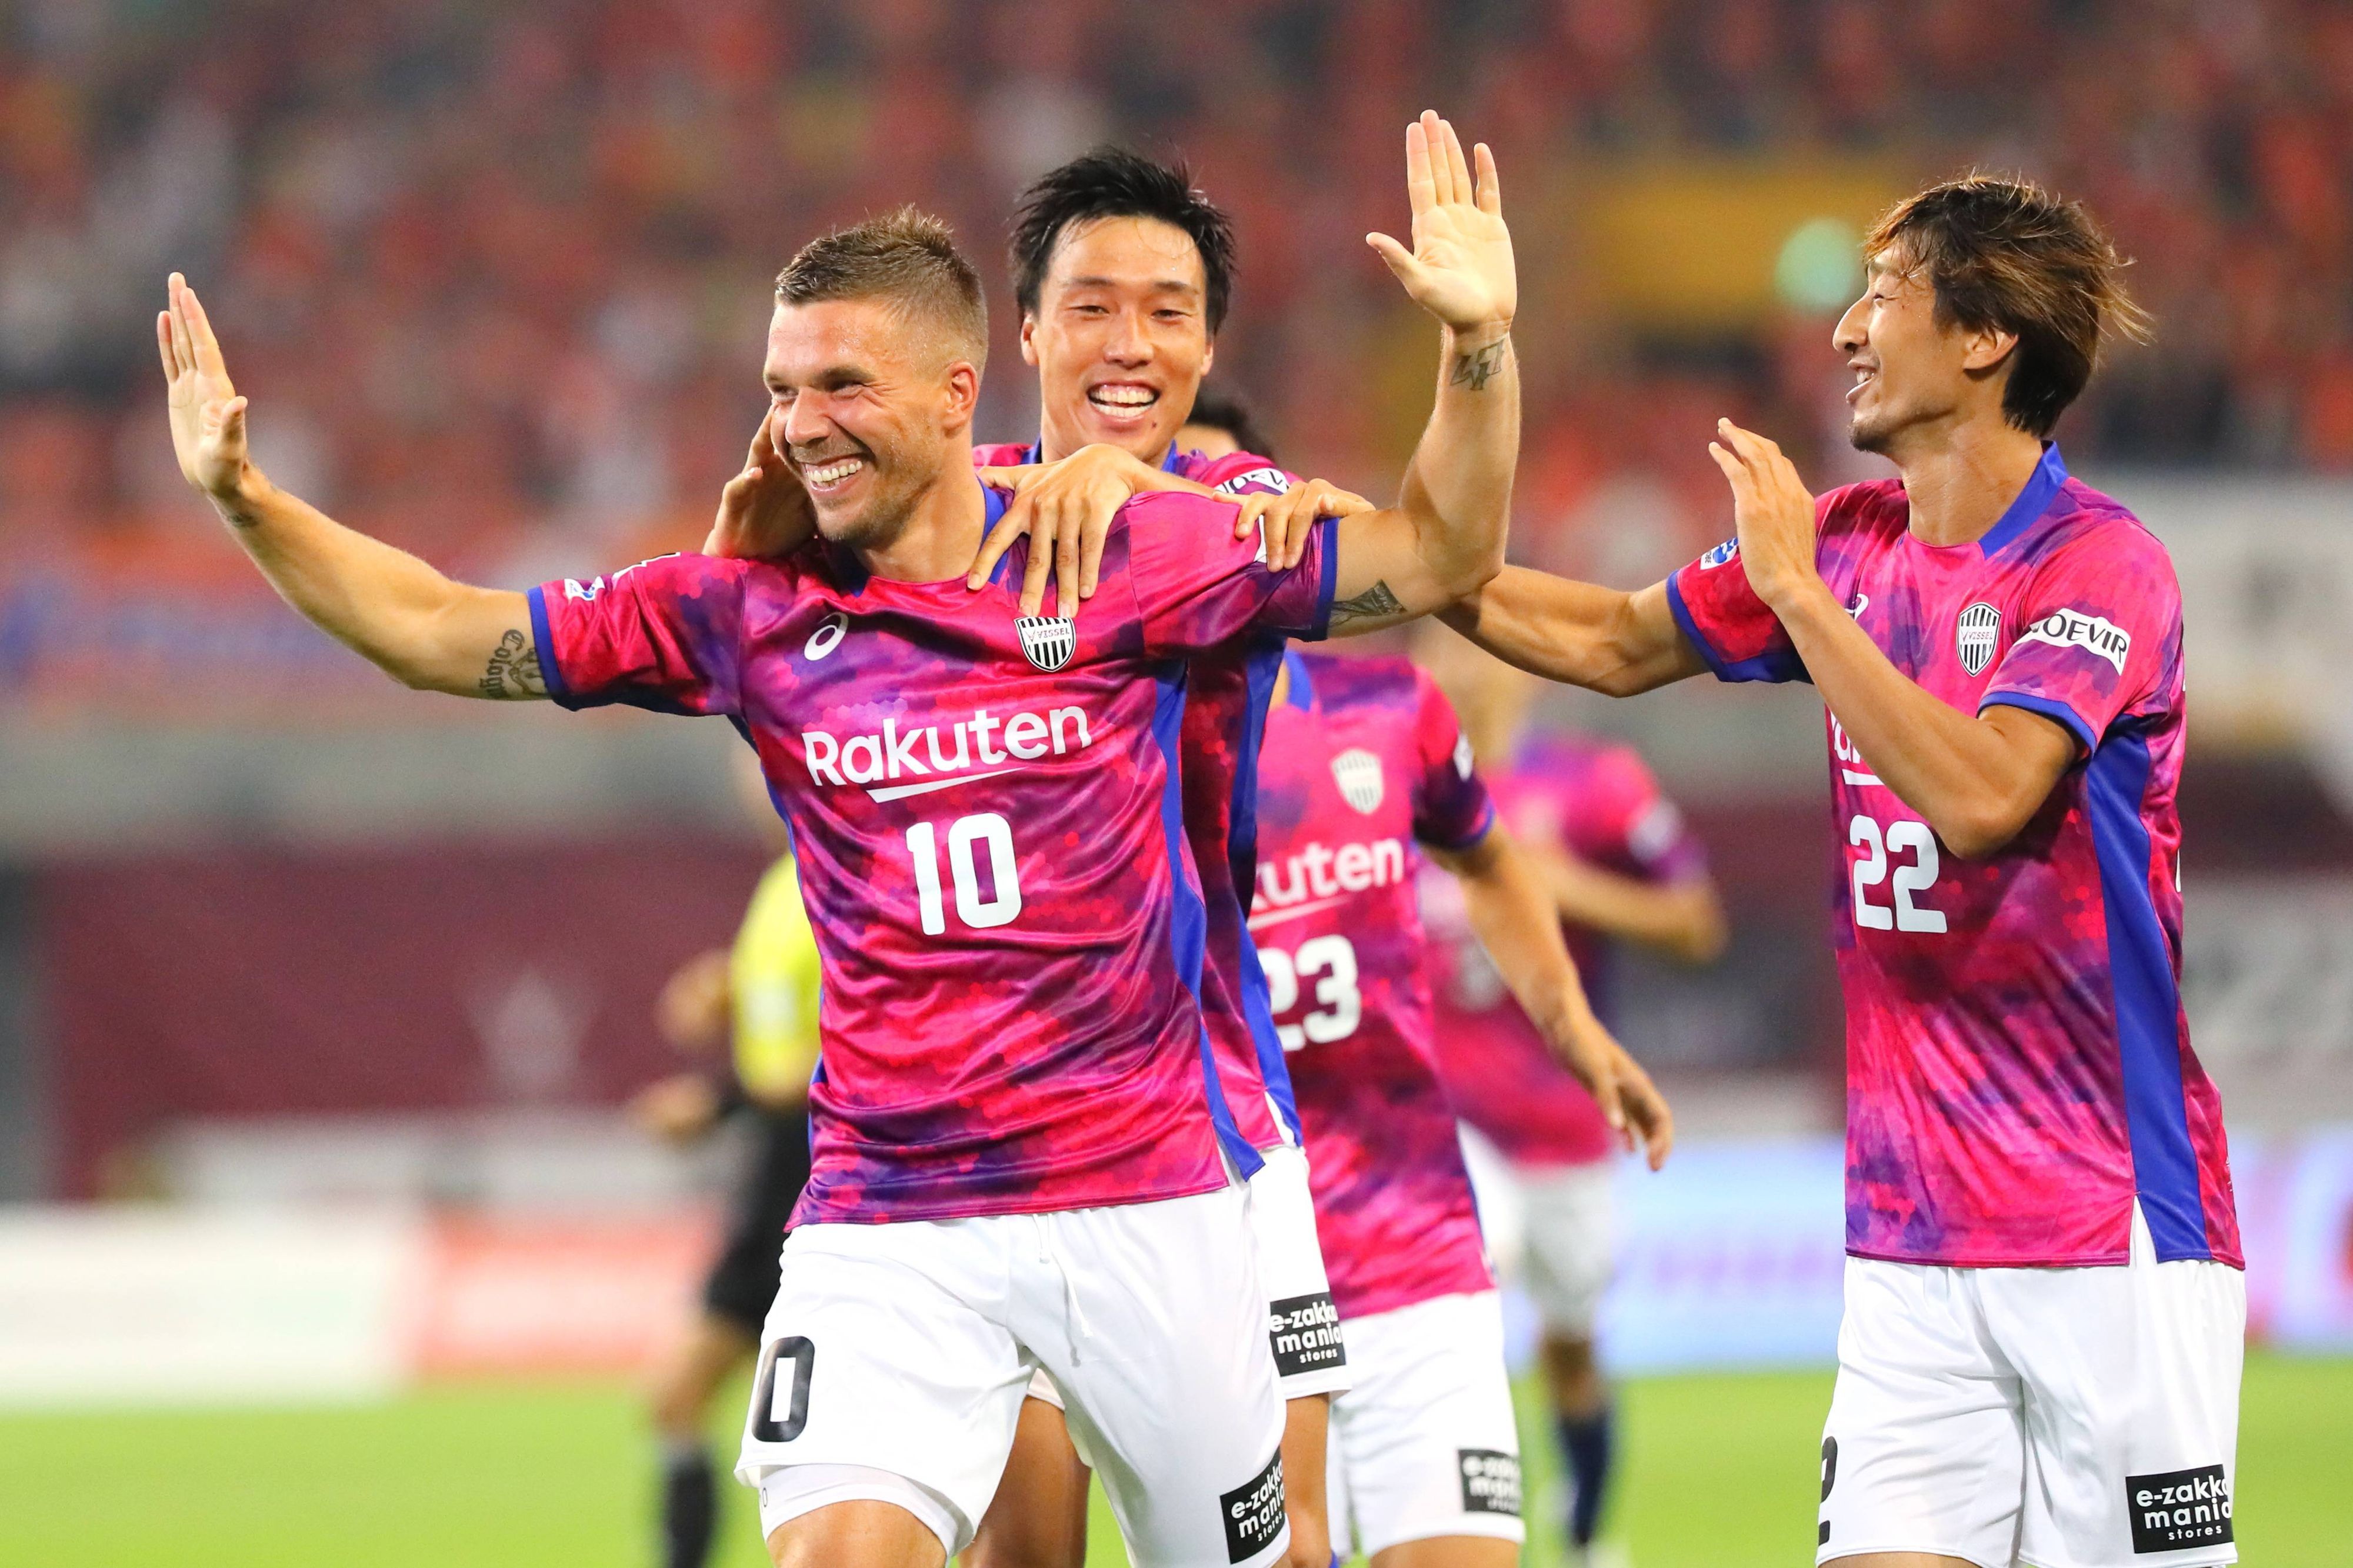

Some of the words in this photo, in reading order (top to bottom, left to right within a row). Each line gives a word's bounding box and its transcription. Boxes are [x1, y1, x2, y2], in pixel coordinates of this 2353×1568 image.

[2032, 613, 2127, 664] OEVIR
[801, 705, 1092, 787] Rakuten
[905, 812, 1022, 936] 10
[1849, 814, 1948, 934] 22
[1257, 934, 1362, 1052] 23
[751, 1336, 815, 1443] 0
[1299, 1348, 1338, 1364] stores
[1257, 1510, 1283, 1542] stores
[2168, 1524, 2222, 1540] stores
